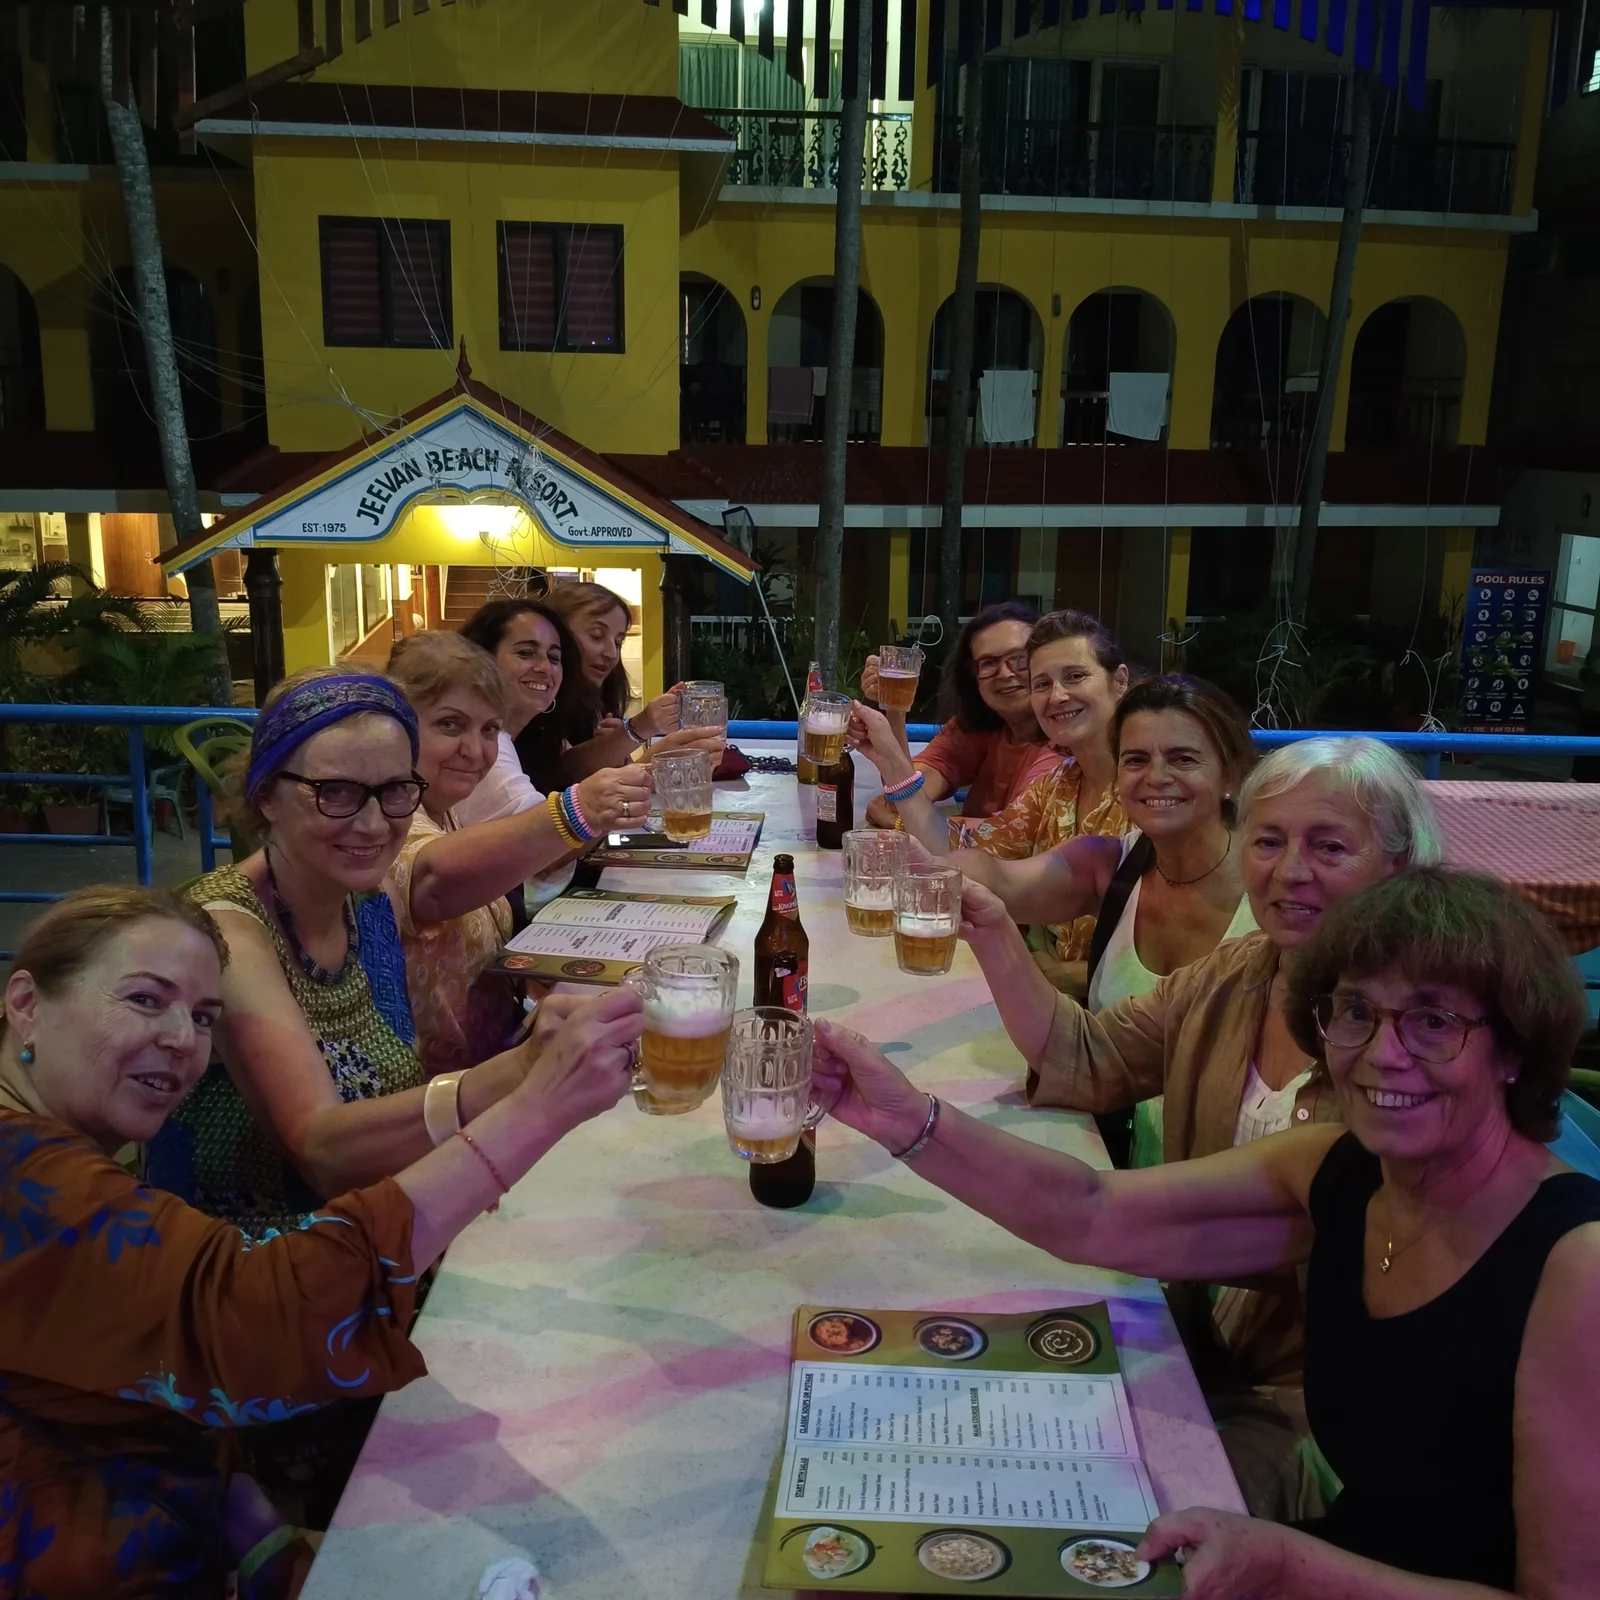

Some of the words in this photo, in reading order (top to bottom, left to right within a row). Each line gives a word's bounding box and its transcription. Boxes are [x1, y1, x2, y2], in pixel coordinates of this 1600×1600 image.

[356, 457, 422, 526] JEEVAN
[425, 448, 499, 472] BEACH
[504, 457, 579, 521] RSORT
[1476, 575, 1506, 584] POOL
[1508, 576, 1545, 585] RULES
[970, 1388, 978, 1404] VEGGIE
[971, 1406, 979, 1423] COURSE
[799, 1415, 808, 1434] CLASSIC
[799, 1457, 807, 1470] SALAD
[795, 1484, 804, 1497] START
